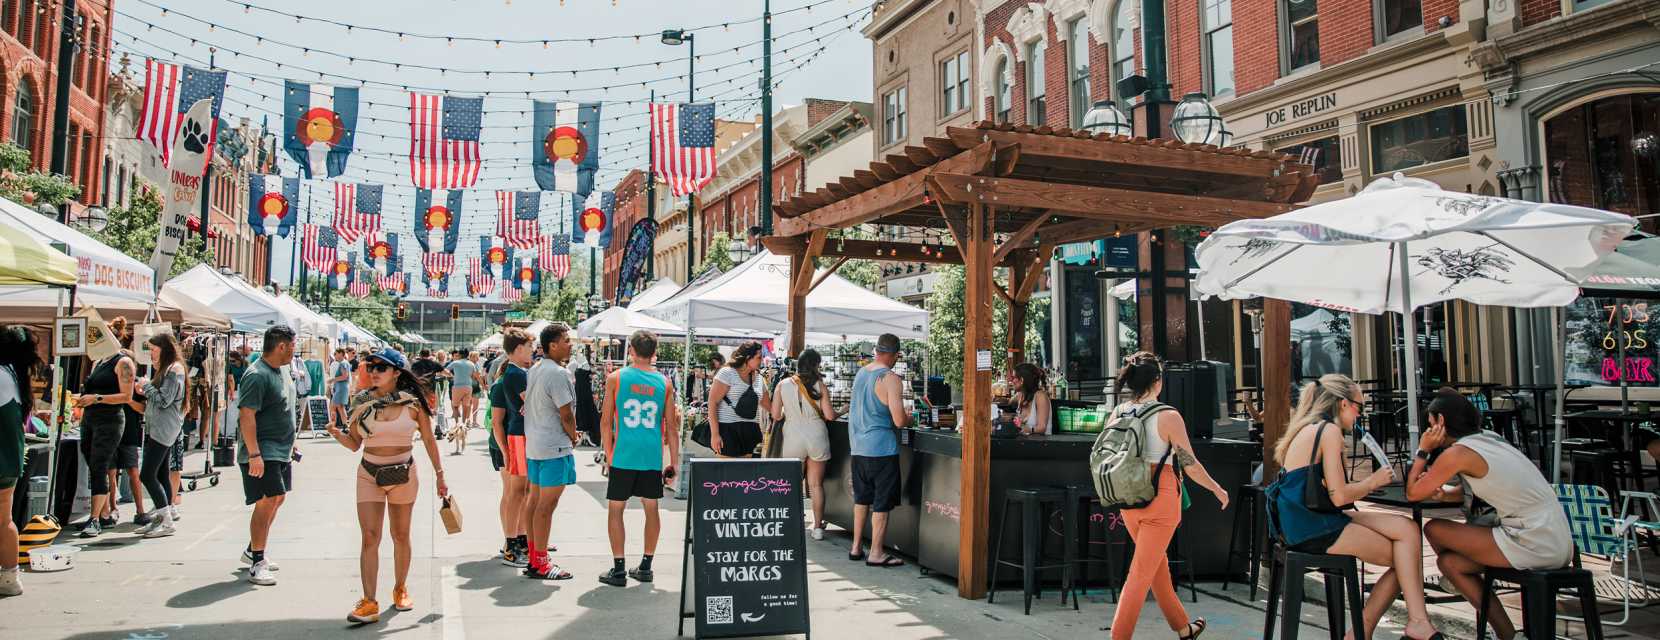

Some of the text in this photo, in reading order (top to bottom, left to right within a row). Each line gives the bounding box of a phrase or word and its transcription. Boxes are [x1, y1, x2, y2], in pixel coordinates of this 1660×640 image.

[1266, 93, 1336, 128] JOE REPLIN
[95, 263, 113, 287] DOG
[623, 399, 658, 428] 33
[703, 507, 790, 520] COME FOR THE
[744, 550, 767, 562] FOR
[772, 549, 795, 561] THE
